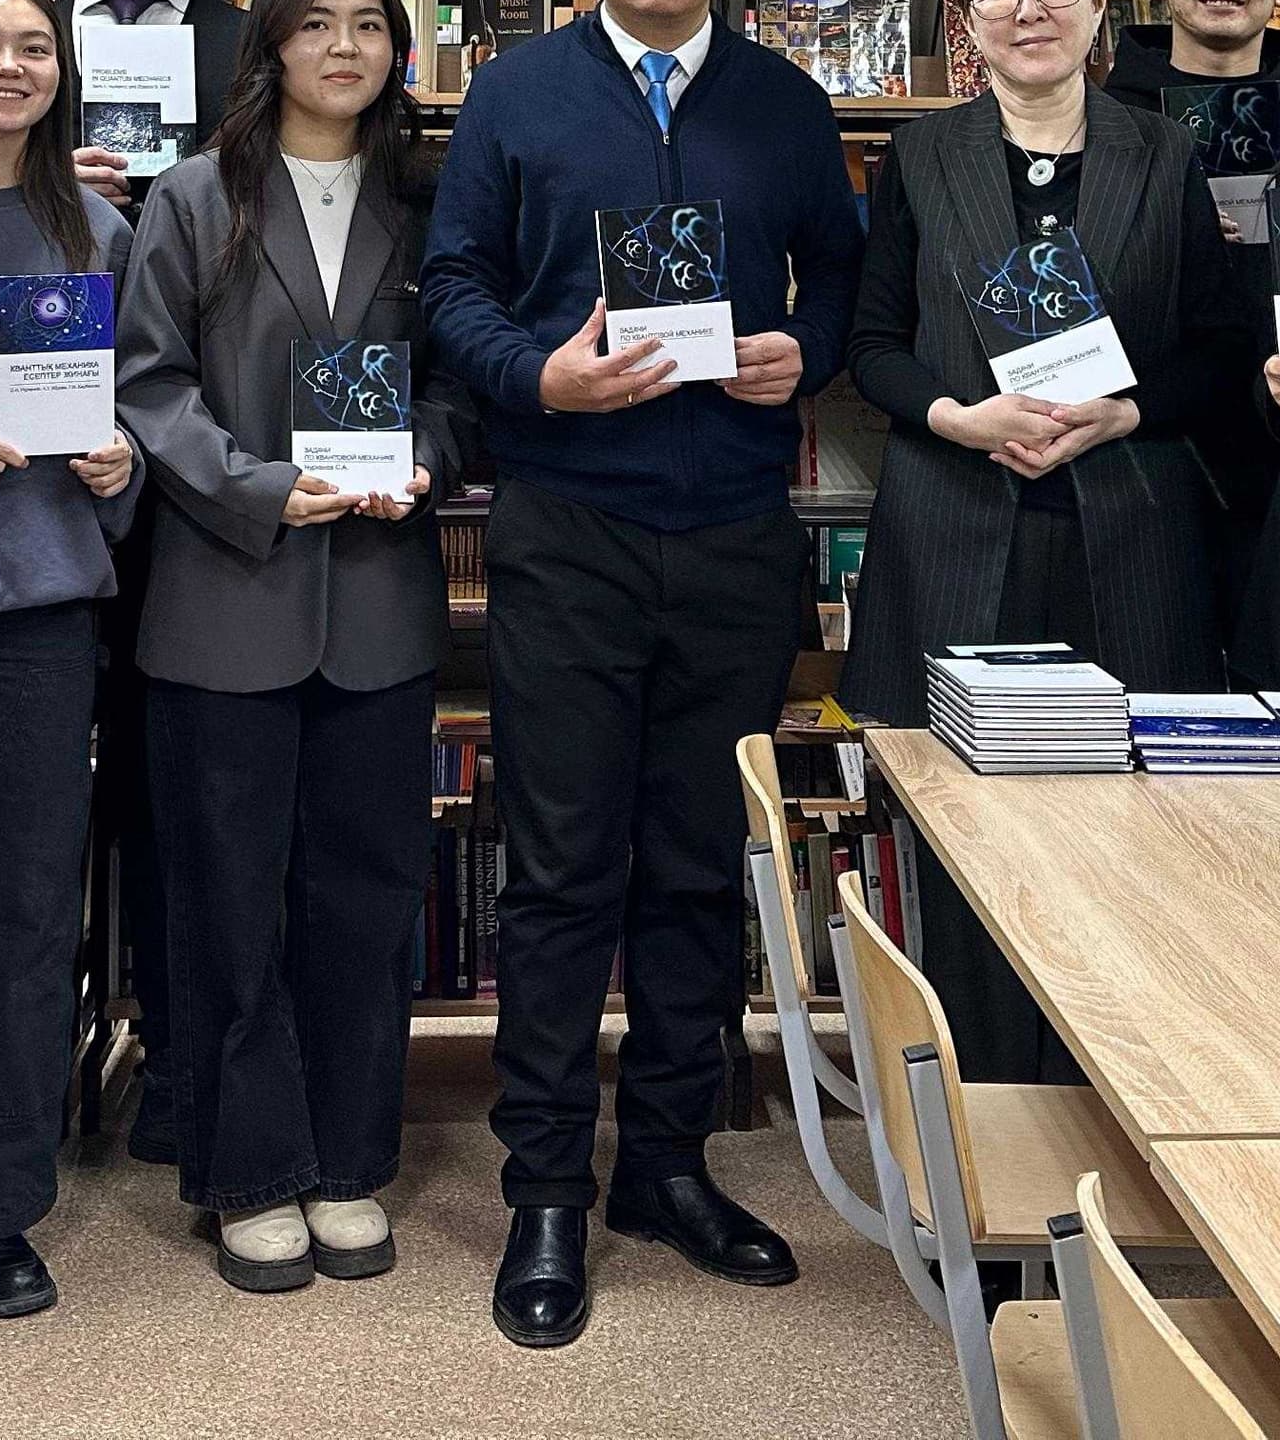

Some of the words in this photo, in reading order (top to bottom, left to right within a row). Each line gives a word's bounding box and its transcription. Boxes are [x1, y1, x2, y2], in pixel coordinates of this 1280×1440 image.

[499, 8, 529, 19] Room
[23, 371, 62, 381] ЕСЕПТЕР
[486, 892, 496, 936] INDIA
